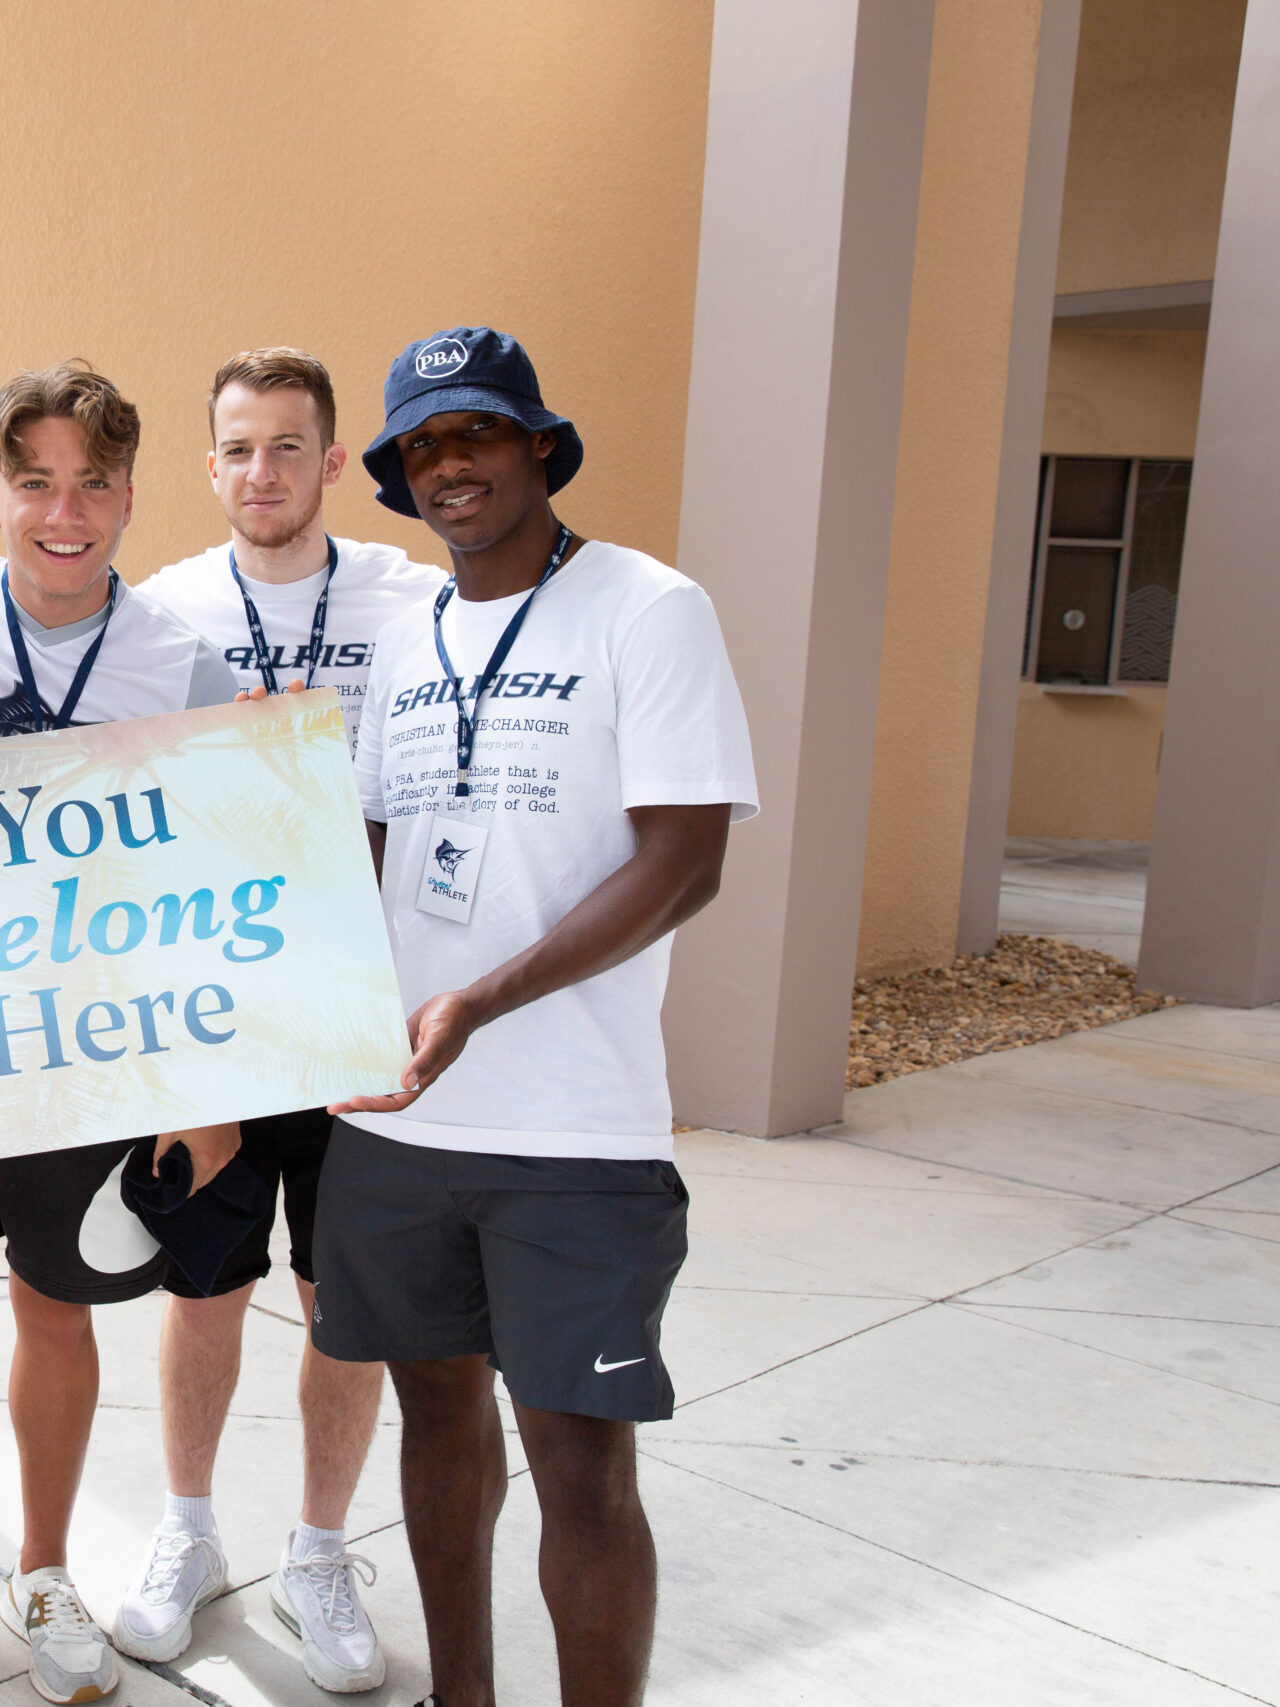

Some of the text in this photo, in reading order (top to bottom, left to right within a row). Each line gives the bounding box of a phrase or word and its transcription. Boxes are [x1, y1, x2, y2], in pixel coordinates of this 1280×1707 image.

[420, 349, 463, 372] PBA
[389, 722, 446, 748] CHRISTIAN
[396, 772, 414, 787] PBA
[508, 765, 538, 779] that
[547, 768, 560, 780] is
[506, 783, 557, 798] college
[421, 800, 440, 812] for
[471, 798, 497, 813] glory
[504, 799, 520, 810] of
[528, 800, 561, 814] God.
[431, 884, 469, 903] ATHLETE
